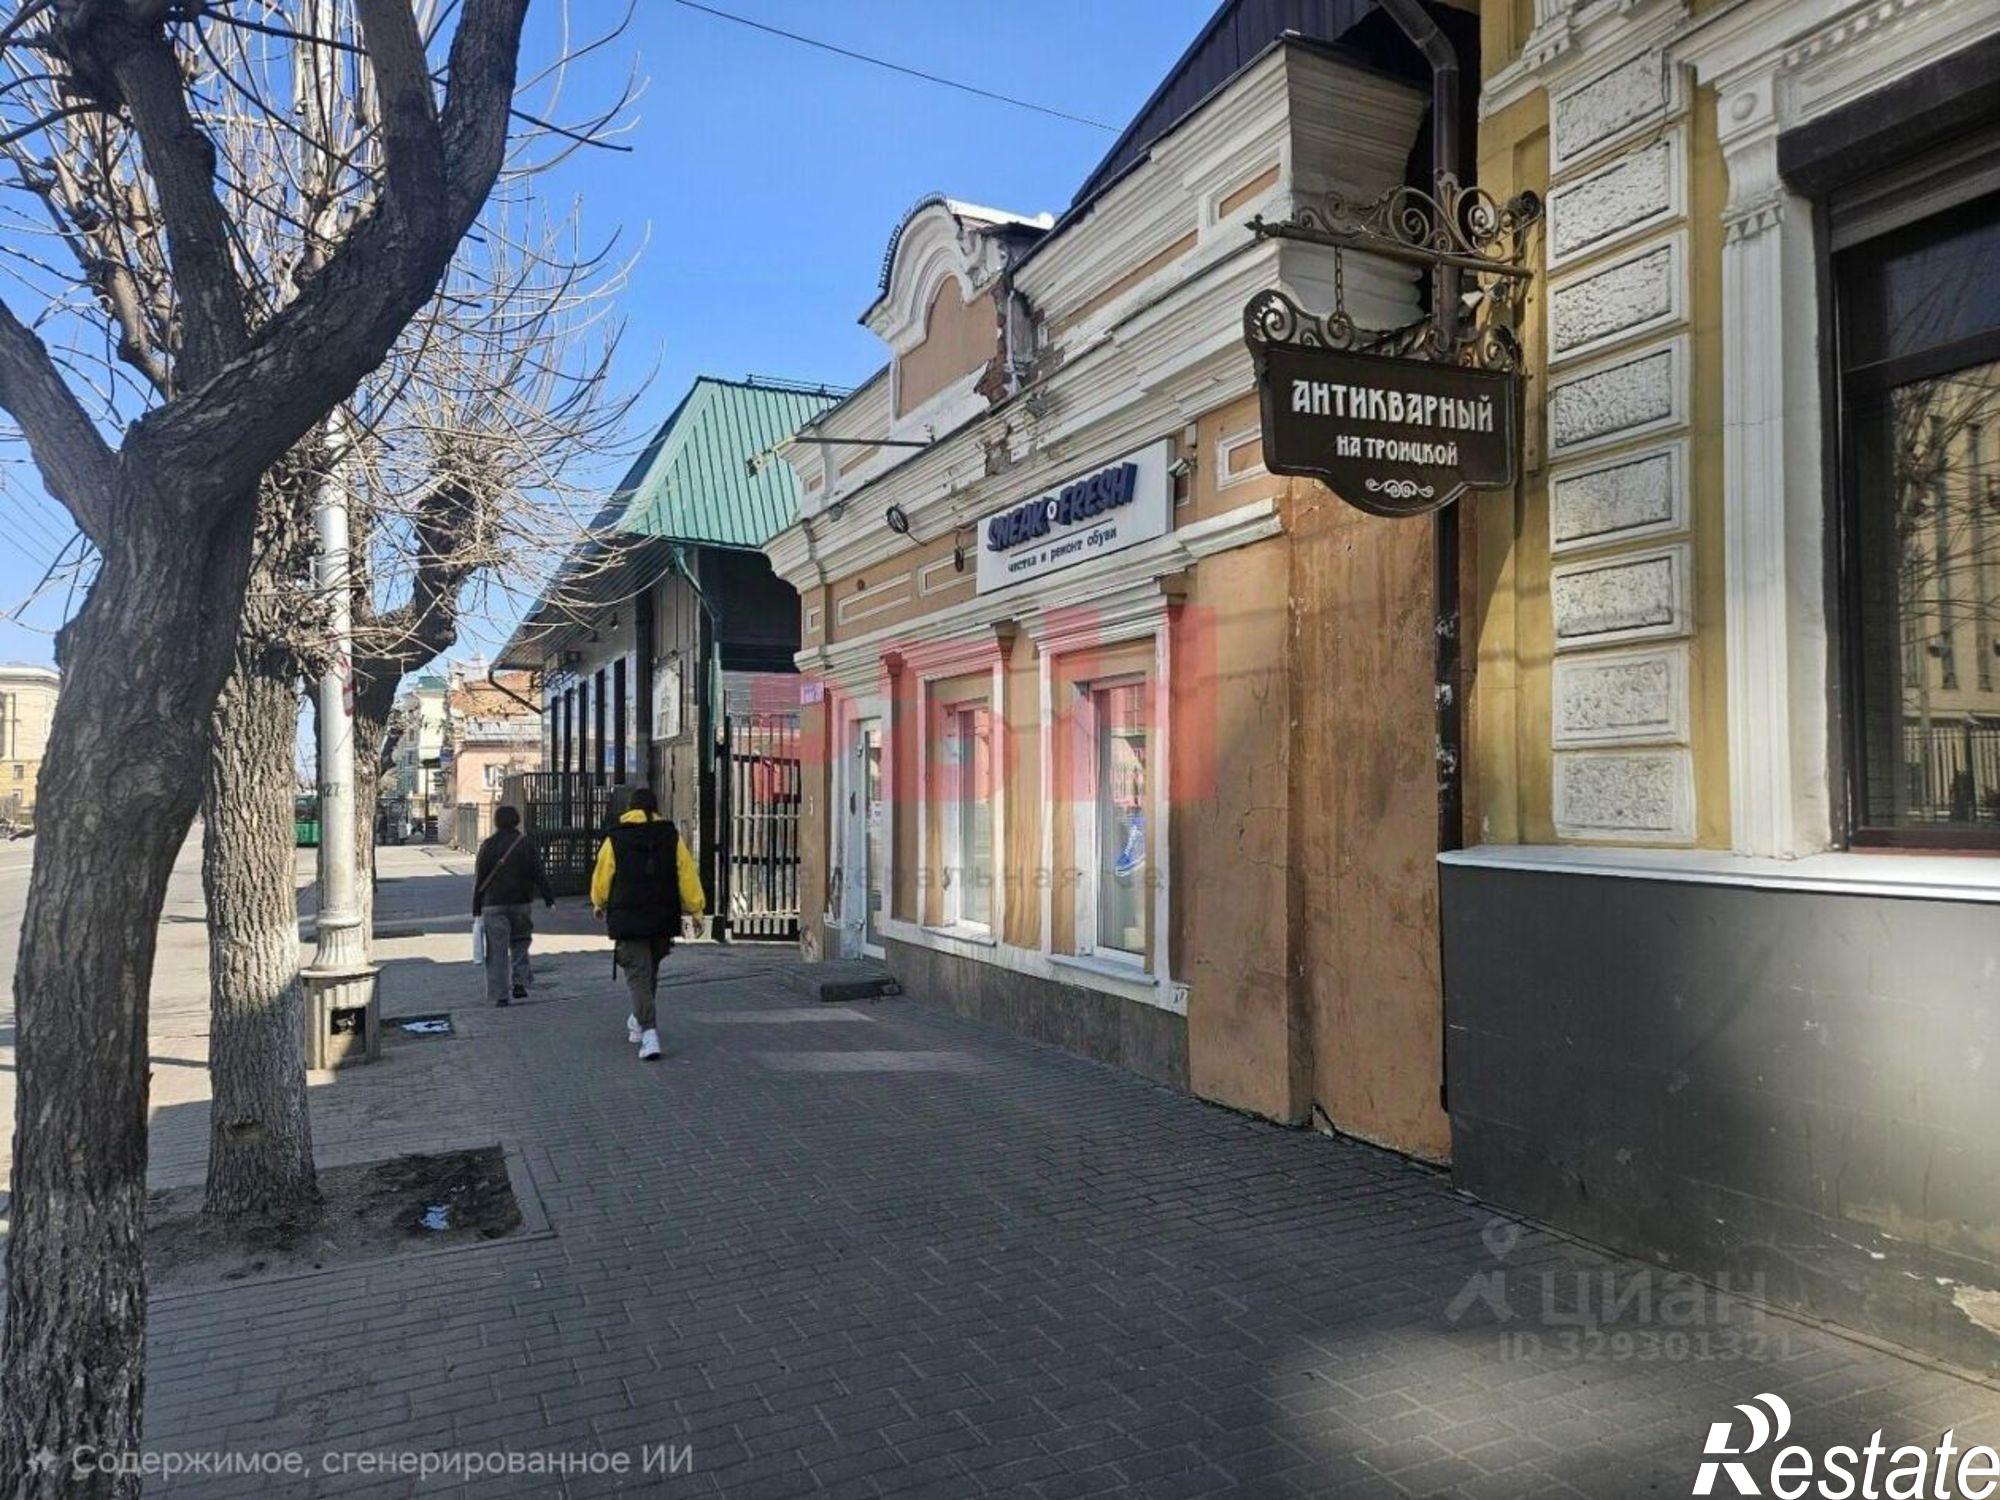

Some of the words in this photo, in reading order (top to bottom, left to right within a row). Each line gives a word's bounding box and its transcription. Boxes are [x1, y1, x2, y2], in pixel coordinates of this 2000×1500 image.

[1291, 379, 1494, 433] АНТИКВАРНЫЙ
[1336, 435, 1362, 457] НА
[1364, 437, 1459, 466] ТРОИЦКОЙ
[986, 497, 1054, 552] SNEAK
[1058, 462, 1138, 525] FRESH
[1008, 555, 1037, 573] чистка
[1041, 552, 1047, 564] и
[1050, 540, 1082, 563] ремонт
[1087, 527, 1117, 547] обуви
